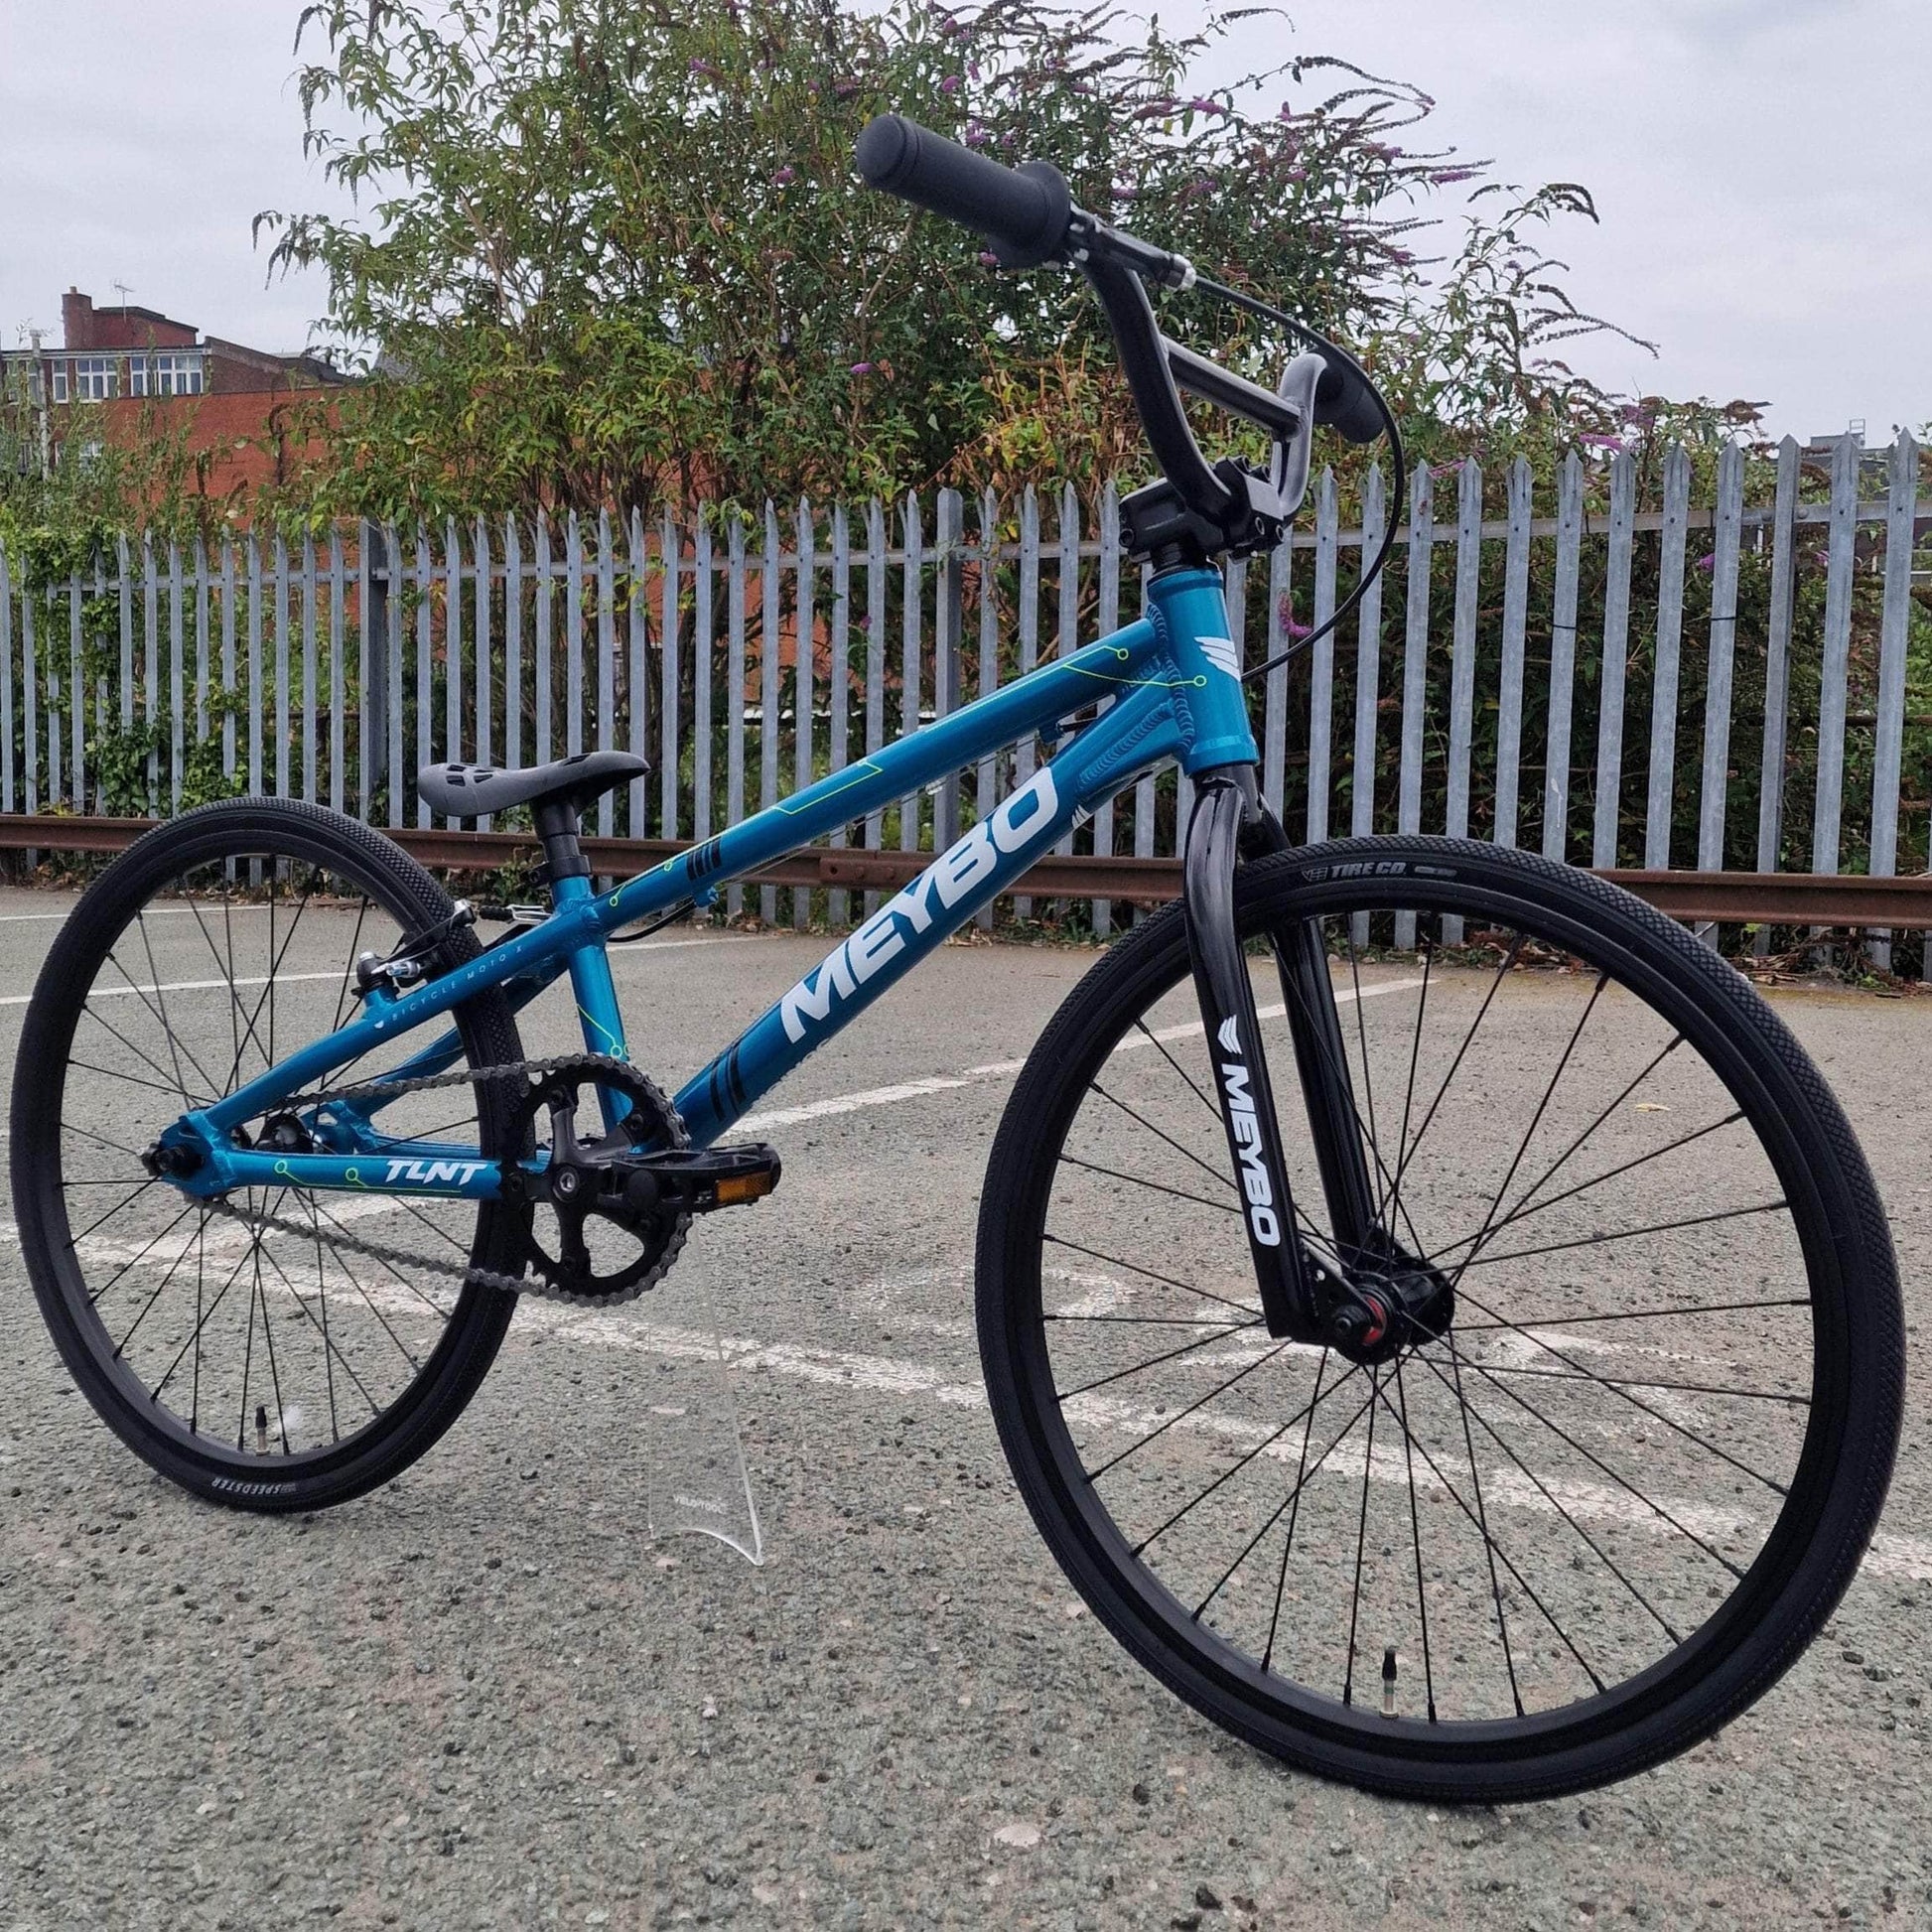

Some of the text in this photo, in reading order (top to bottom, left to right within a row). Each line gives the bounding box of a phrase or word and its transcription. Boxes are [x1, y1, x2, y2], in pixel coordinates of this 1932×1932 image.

[1330, 863, 1374, 878] TIRE
[780, 766, 1058, 1043] MEYBO
[392, 945, 522, 1021] BICYCLE MOTO X
[385, 1160, 487, 1185] TLNT
[1221, 1063, 1281, 1247] MEYBO
[211, 1477, 282, 1494] SPEEDSTER
